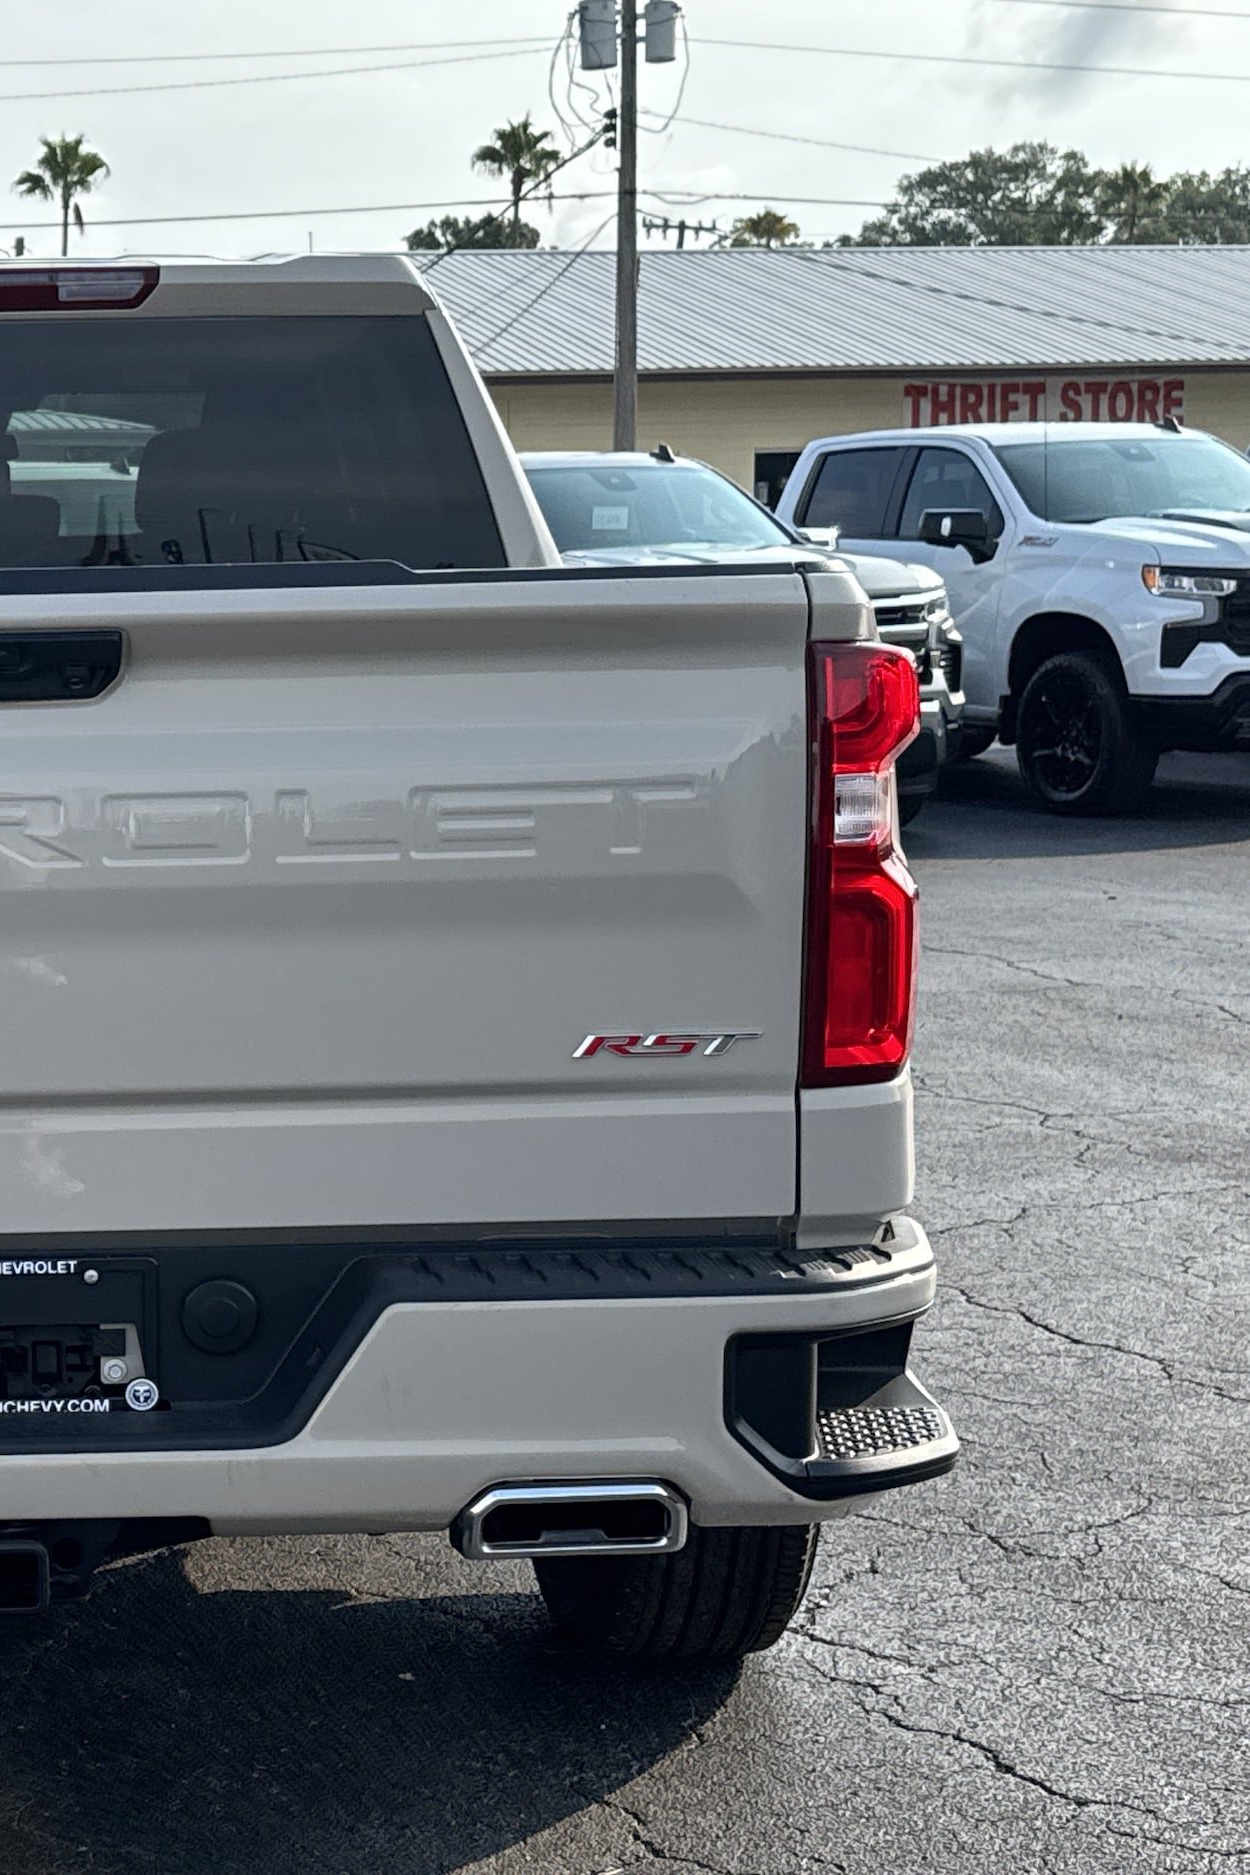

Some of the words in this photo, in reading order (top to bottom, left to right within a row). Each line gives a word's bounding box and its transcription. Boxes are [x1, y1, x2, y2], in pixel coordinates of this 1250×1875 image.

[904, 382, 1046, 428] THRIFT
[1059, 379, 1185, 425] STORE
[571, 1031, 764, 1059] RST
